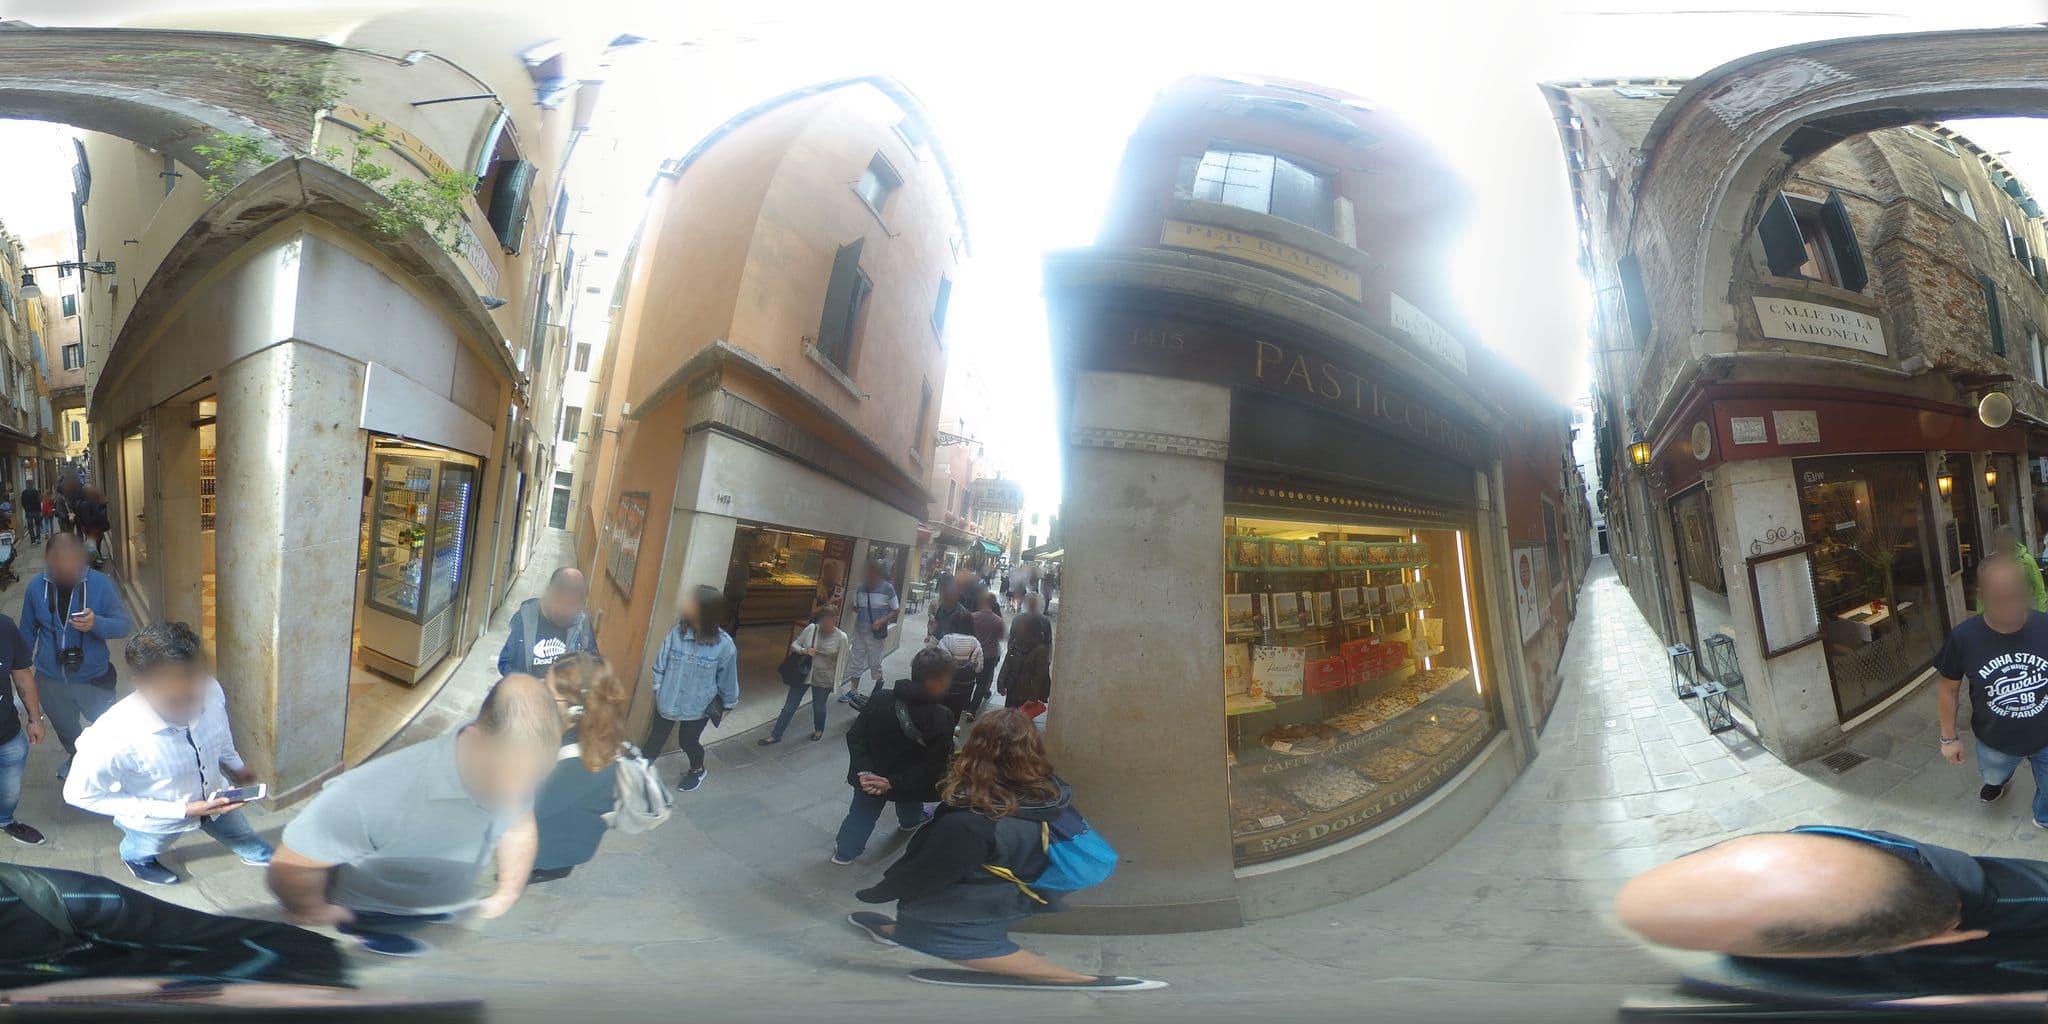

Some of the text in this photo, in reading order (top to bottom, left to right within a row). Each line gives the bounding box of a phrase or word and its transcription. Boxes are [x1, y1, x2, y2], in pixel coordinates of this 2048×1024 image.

[1184, 223, 1350, 281] PER RIALTO
[1769, 304, 1873, 331] CALLE DE LA
[1783, 321, 1869, 344] MADONETA
[1255, 339, 1472, 457] PASTICCERIA
[533, 656, 553, 666] Dead
[1979, 652, 2048, 679] ALOHA STATE
[1984, 669, 2048, 697] Hawaii
[1986, 701, 2010, 718] SURF
[2020, 692, 2036, 704] 98
[1307, 801, 1383, 840] DOLCI
